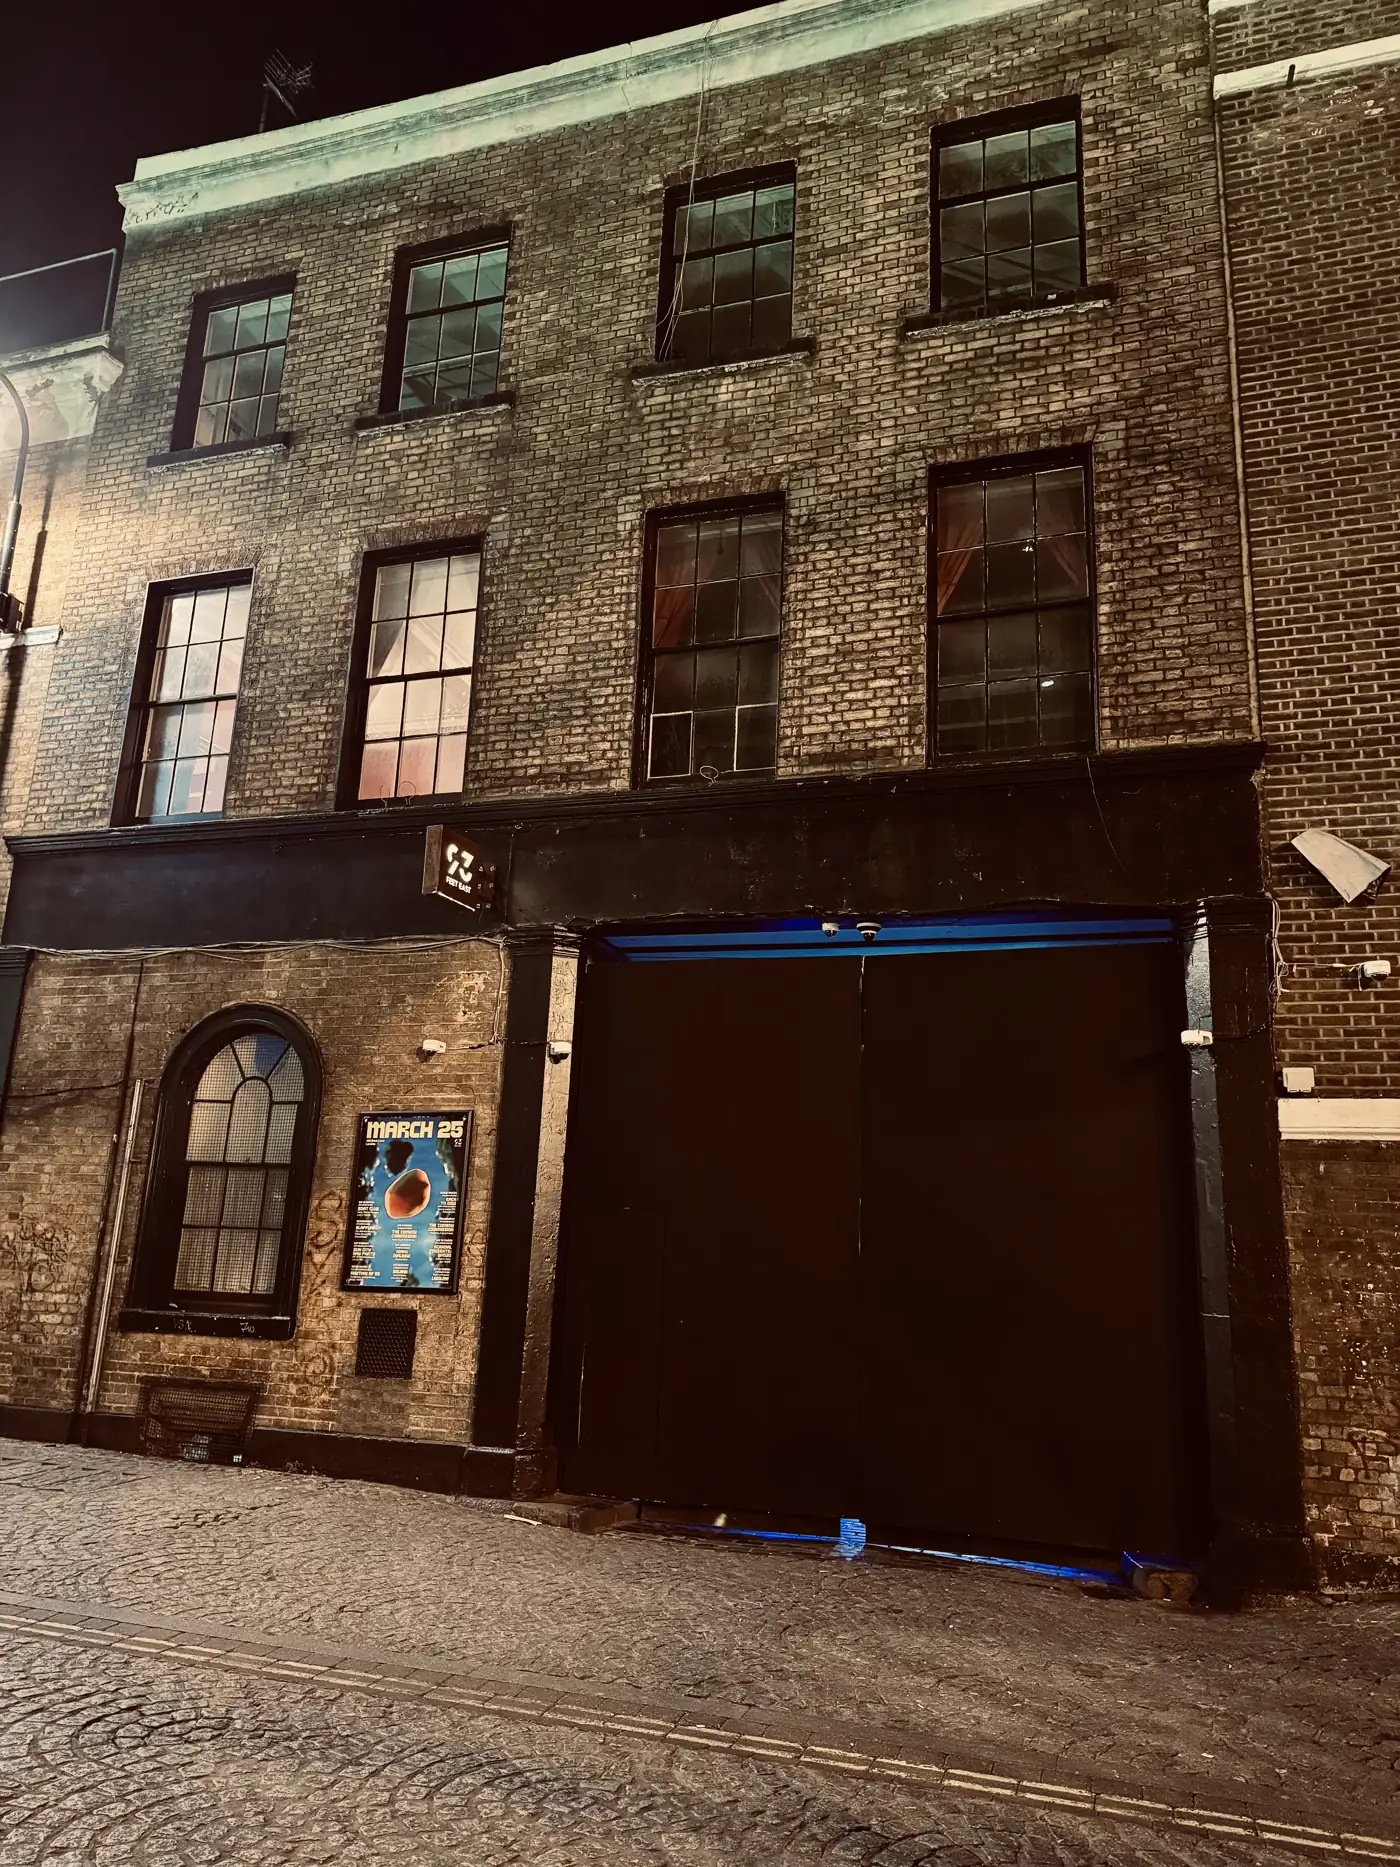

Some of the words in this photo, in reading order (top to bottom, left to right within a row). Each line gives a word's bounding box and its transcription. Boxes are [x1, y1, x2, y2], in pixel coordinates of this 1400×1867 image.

[446, 876, 458, 887] FEET
[458, 882, 471, 894] EAST
[366, 1121, 434, 1139] MARCH
[437, 1120, 464, 1139] 25
